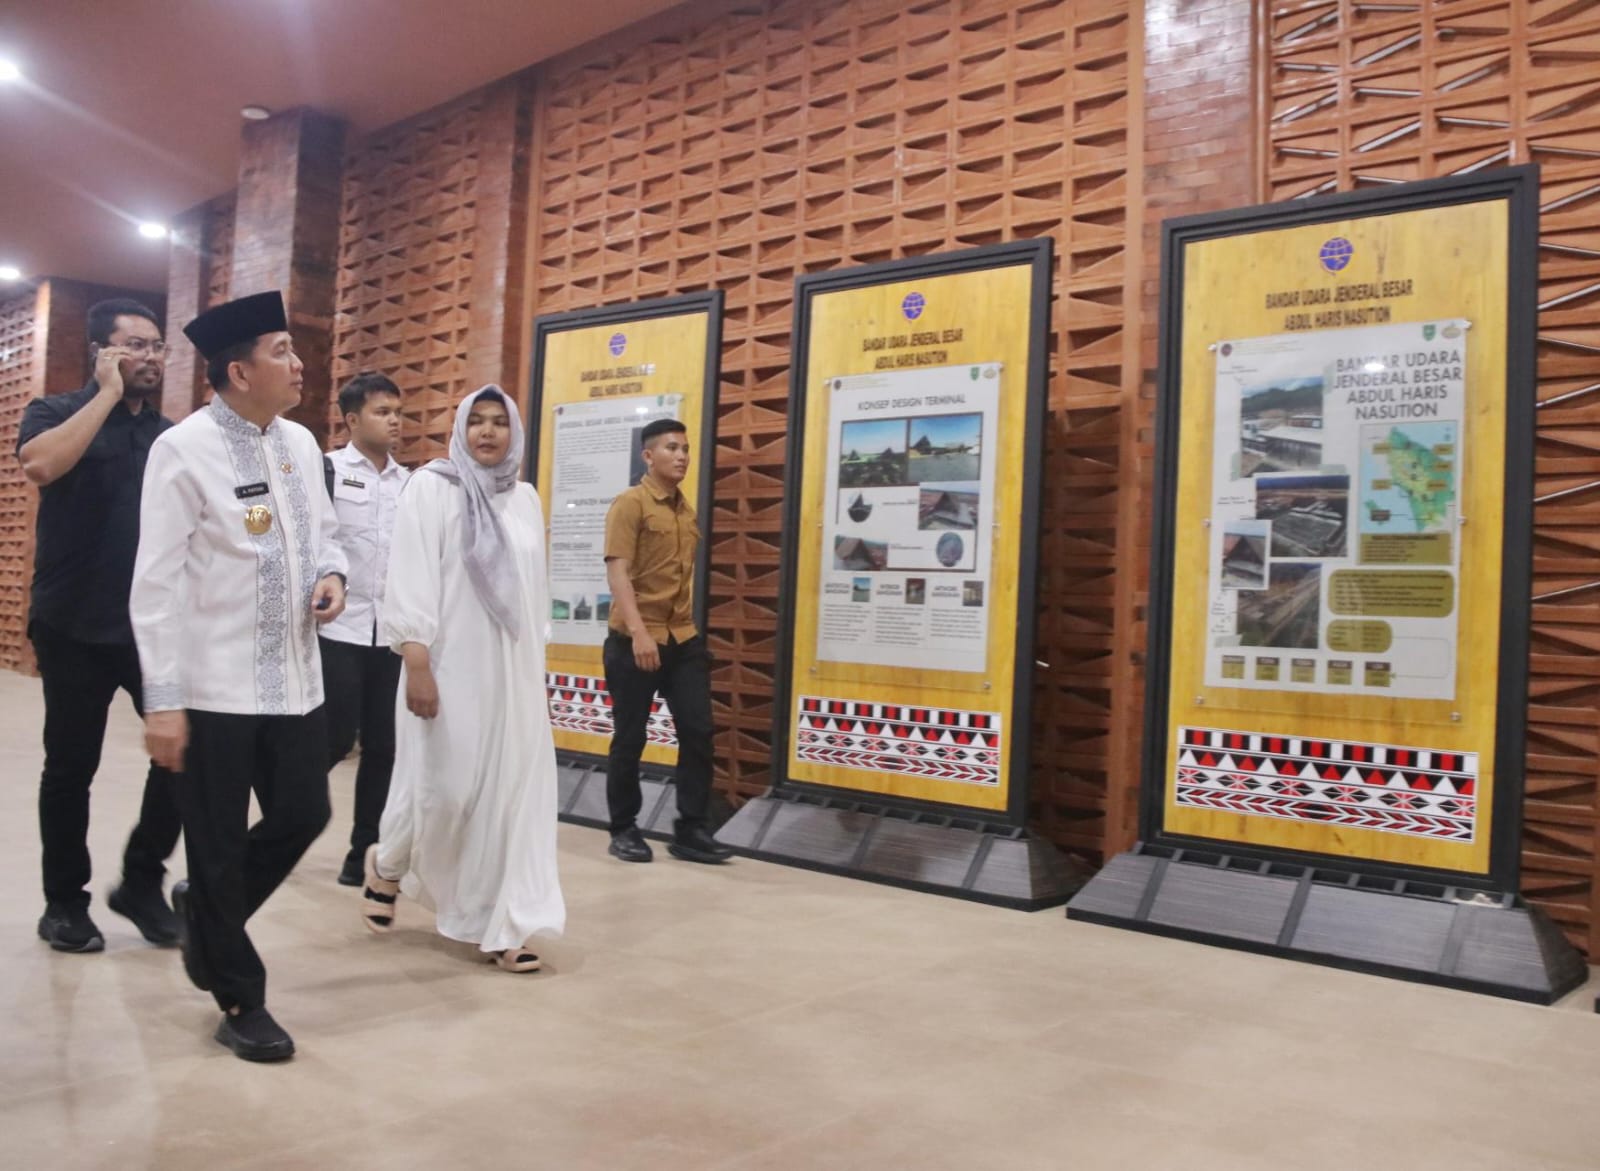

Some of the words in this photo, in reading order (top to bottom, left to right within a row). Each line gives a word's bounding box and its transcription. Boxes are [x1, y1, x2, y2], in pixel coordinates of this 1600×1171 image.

[1266, 292, 1300, 309] BANDAR
[1302, 288, 1331, 306] UDARA
[1334, 284, 1381, 303] JENDERAL
[1383, 279, 1413, 298] BESAR
[1285, 313, 1312, 330] ABDUL
[1315, 310, 1342, 327] HARIS
[1344, 306, 1391, 325] NASUTION
[1405, 350, 1461, 367] UDARA
[1333, 371, 1408, 389] JENDERAL
[1413, 366, 1463, 384] BESAR
[858, 399, 889, 411] KONSEP
[891, 397, 922, 409] DESIGN
[925, 394, 966, 406] TERMINAL
[1347, 388, 1396, 404] ABDUL
[1401, 384, 1448, 401] HARIS
[1355, 402, 1438, 420] NASUTION
